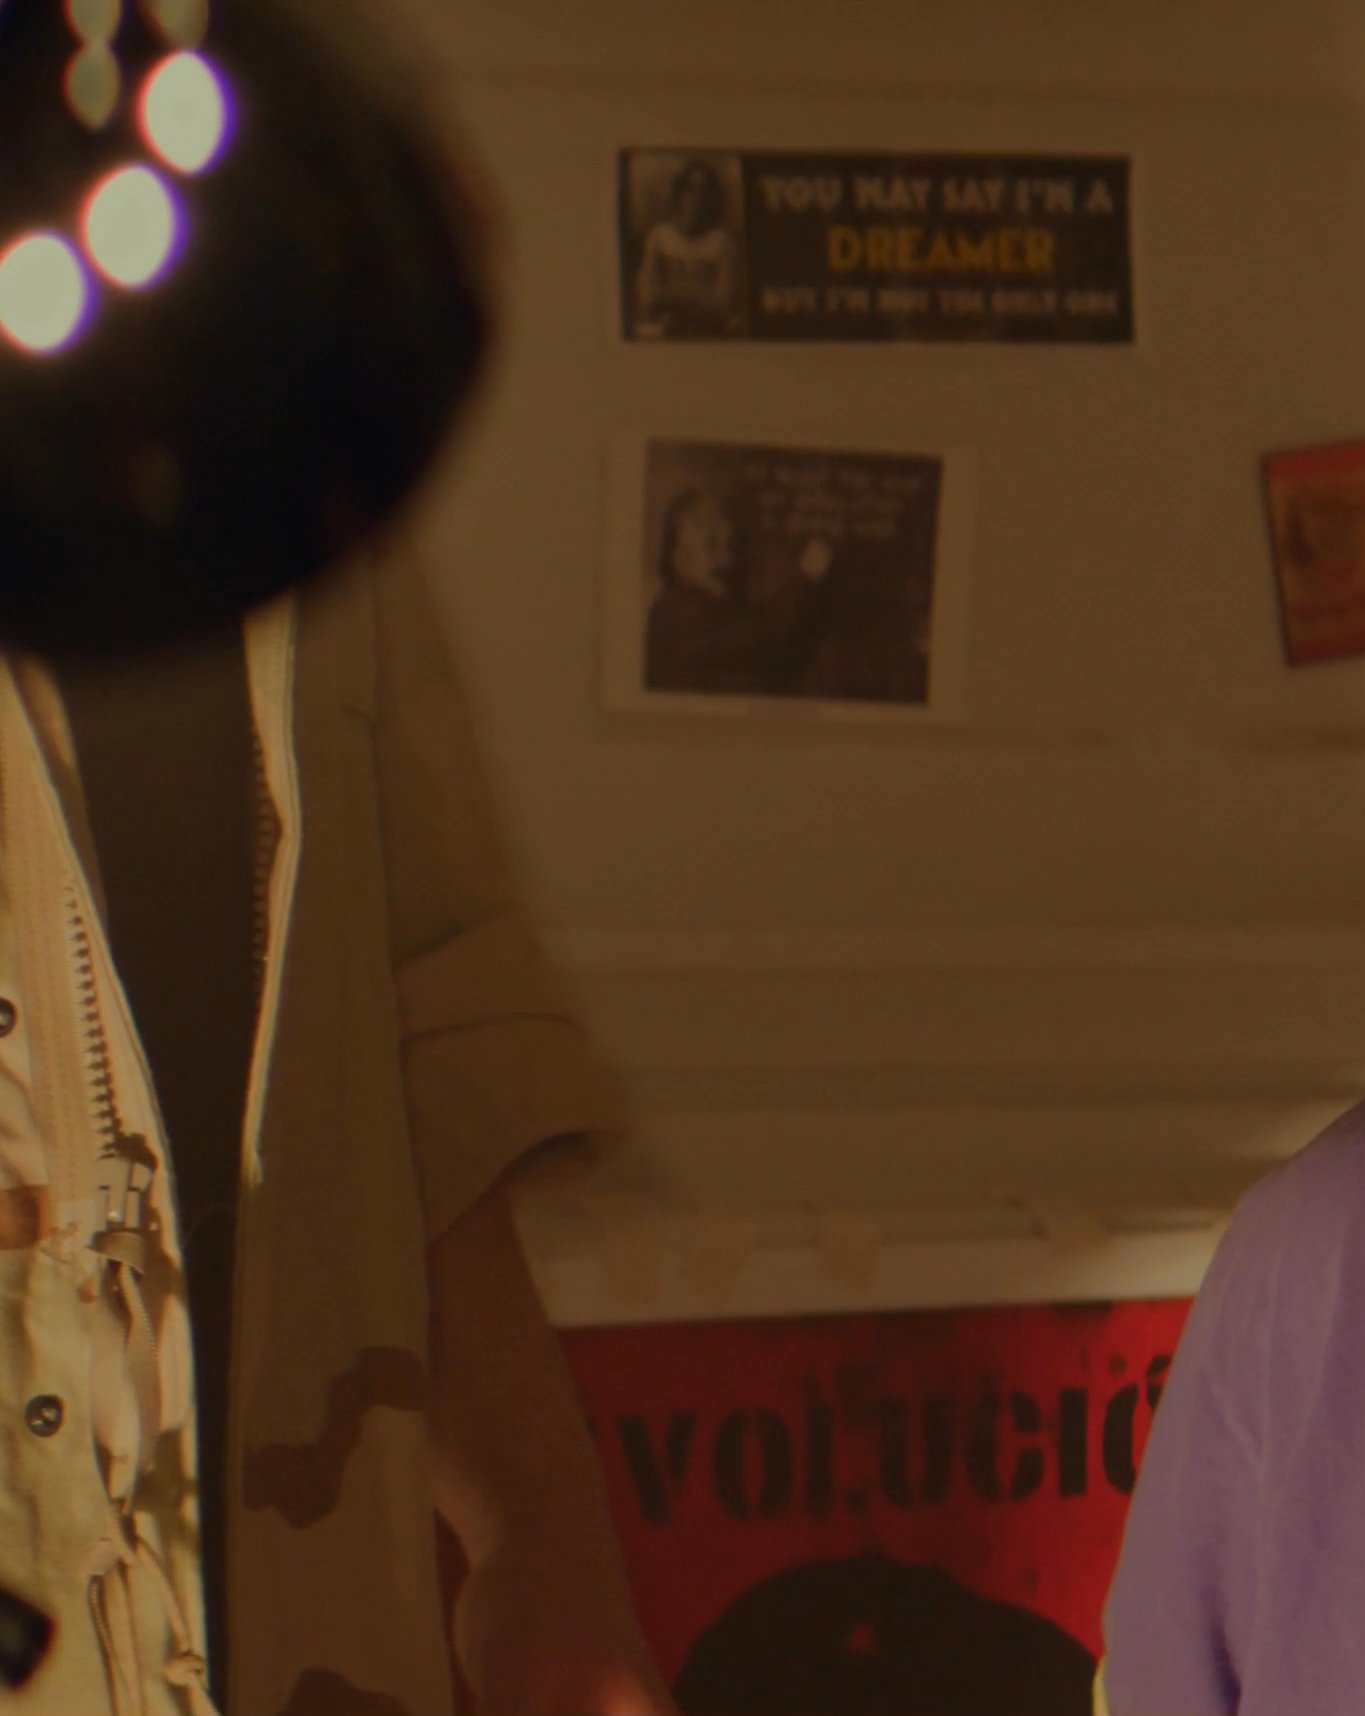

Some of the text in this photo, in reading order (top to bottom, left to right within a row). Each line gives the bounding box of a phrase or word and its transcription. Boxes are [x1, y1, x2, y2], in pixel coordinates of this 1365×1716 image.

[759, 175, 843, 212] YOU
[853, 175, 931, 211] MAY
[1086, 179, 1114, 213] A
[826, 223, 1056, 275] DREAMER
[587, 1354, 1172, 1526] VOLUCIÓ
